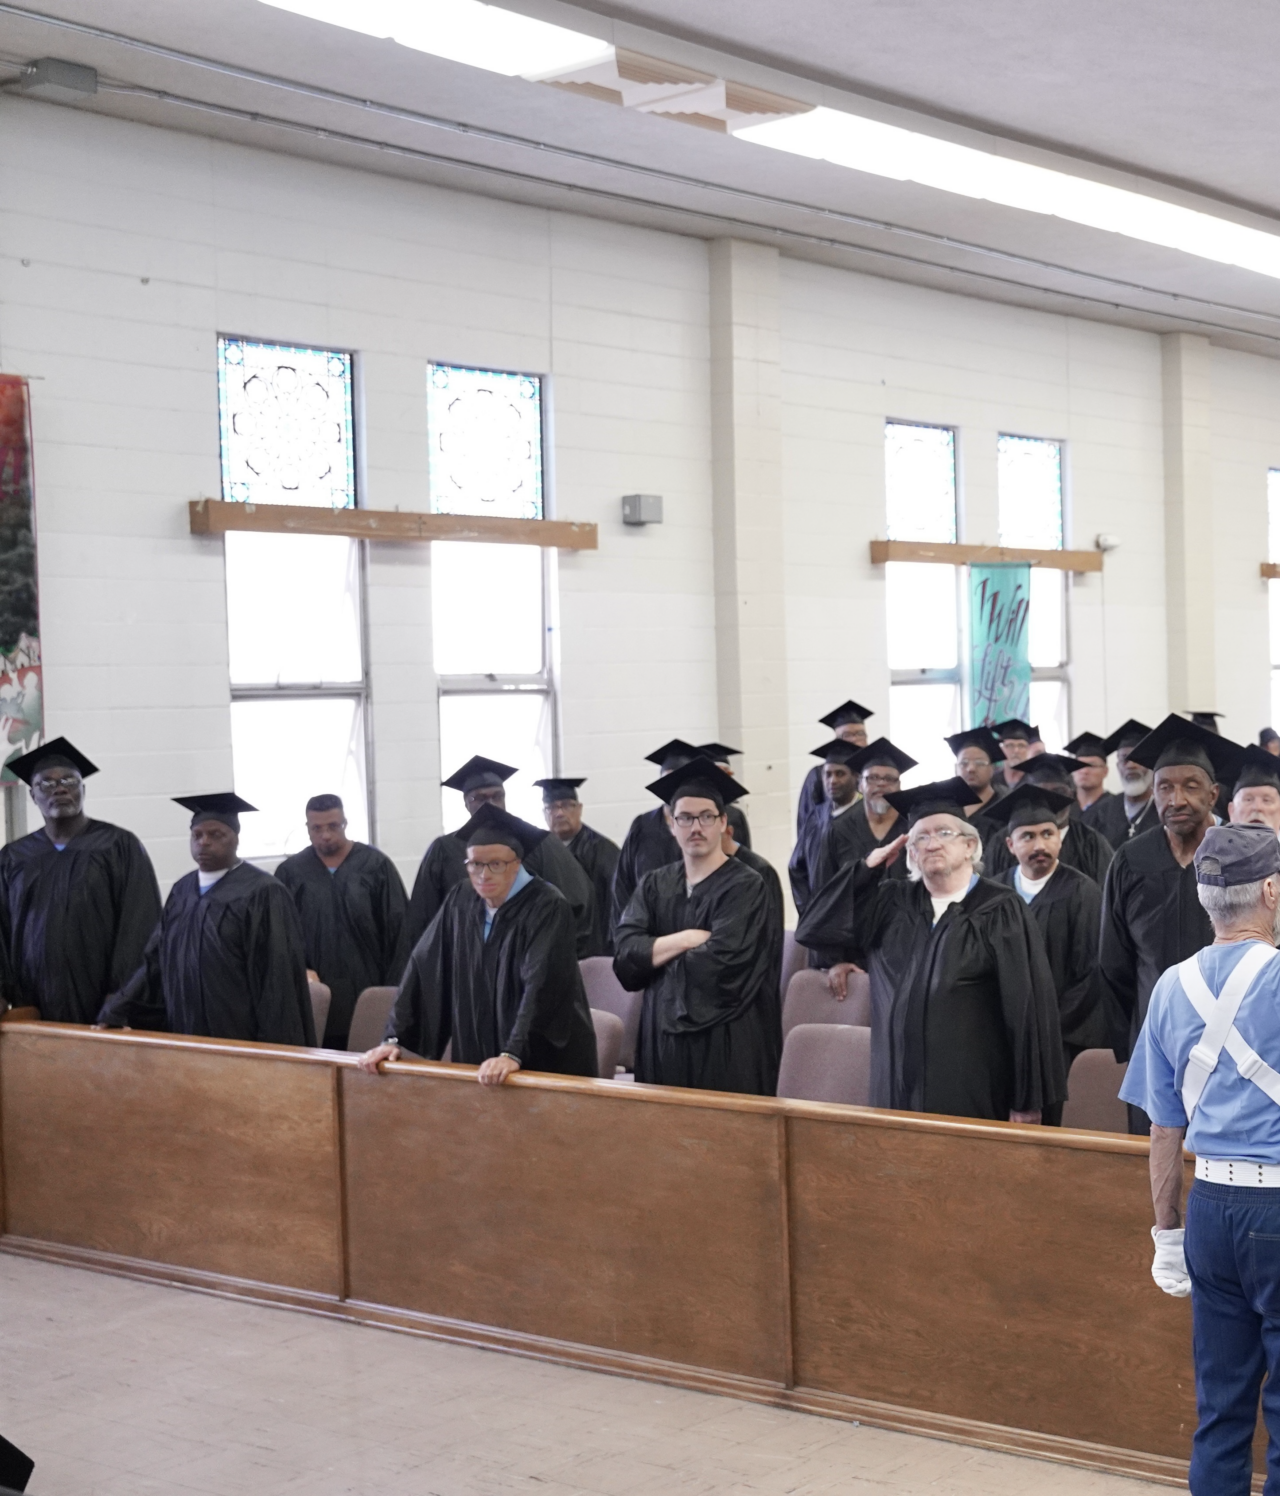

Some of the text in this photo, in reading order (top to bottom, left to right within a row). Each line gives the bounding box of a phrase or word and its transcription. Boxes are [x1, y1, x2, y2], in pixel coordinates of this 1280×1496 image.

[975, 577, 1029, 648] I Will
[974, 643, 1011, 721] Lift
